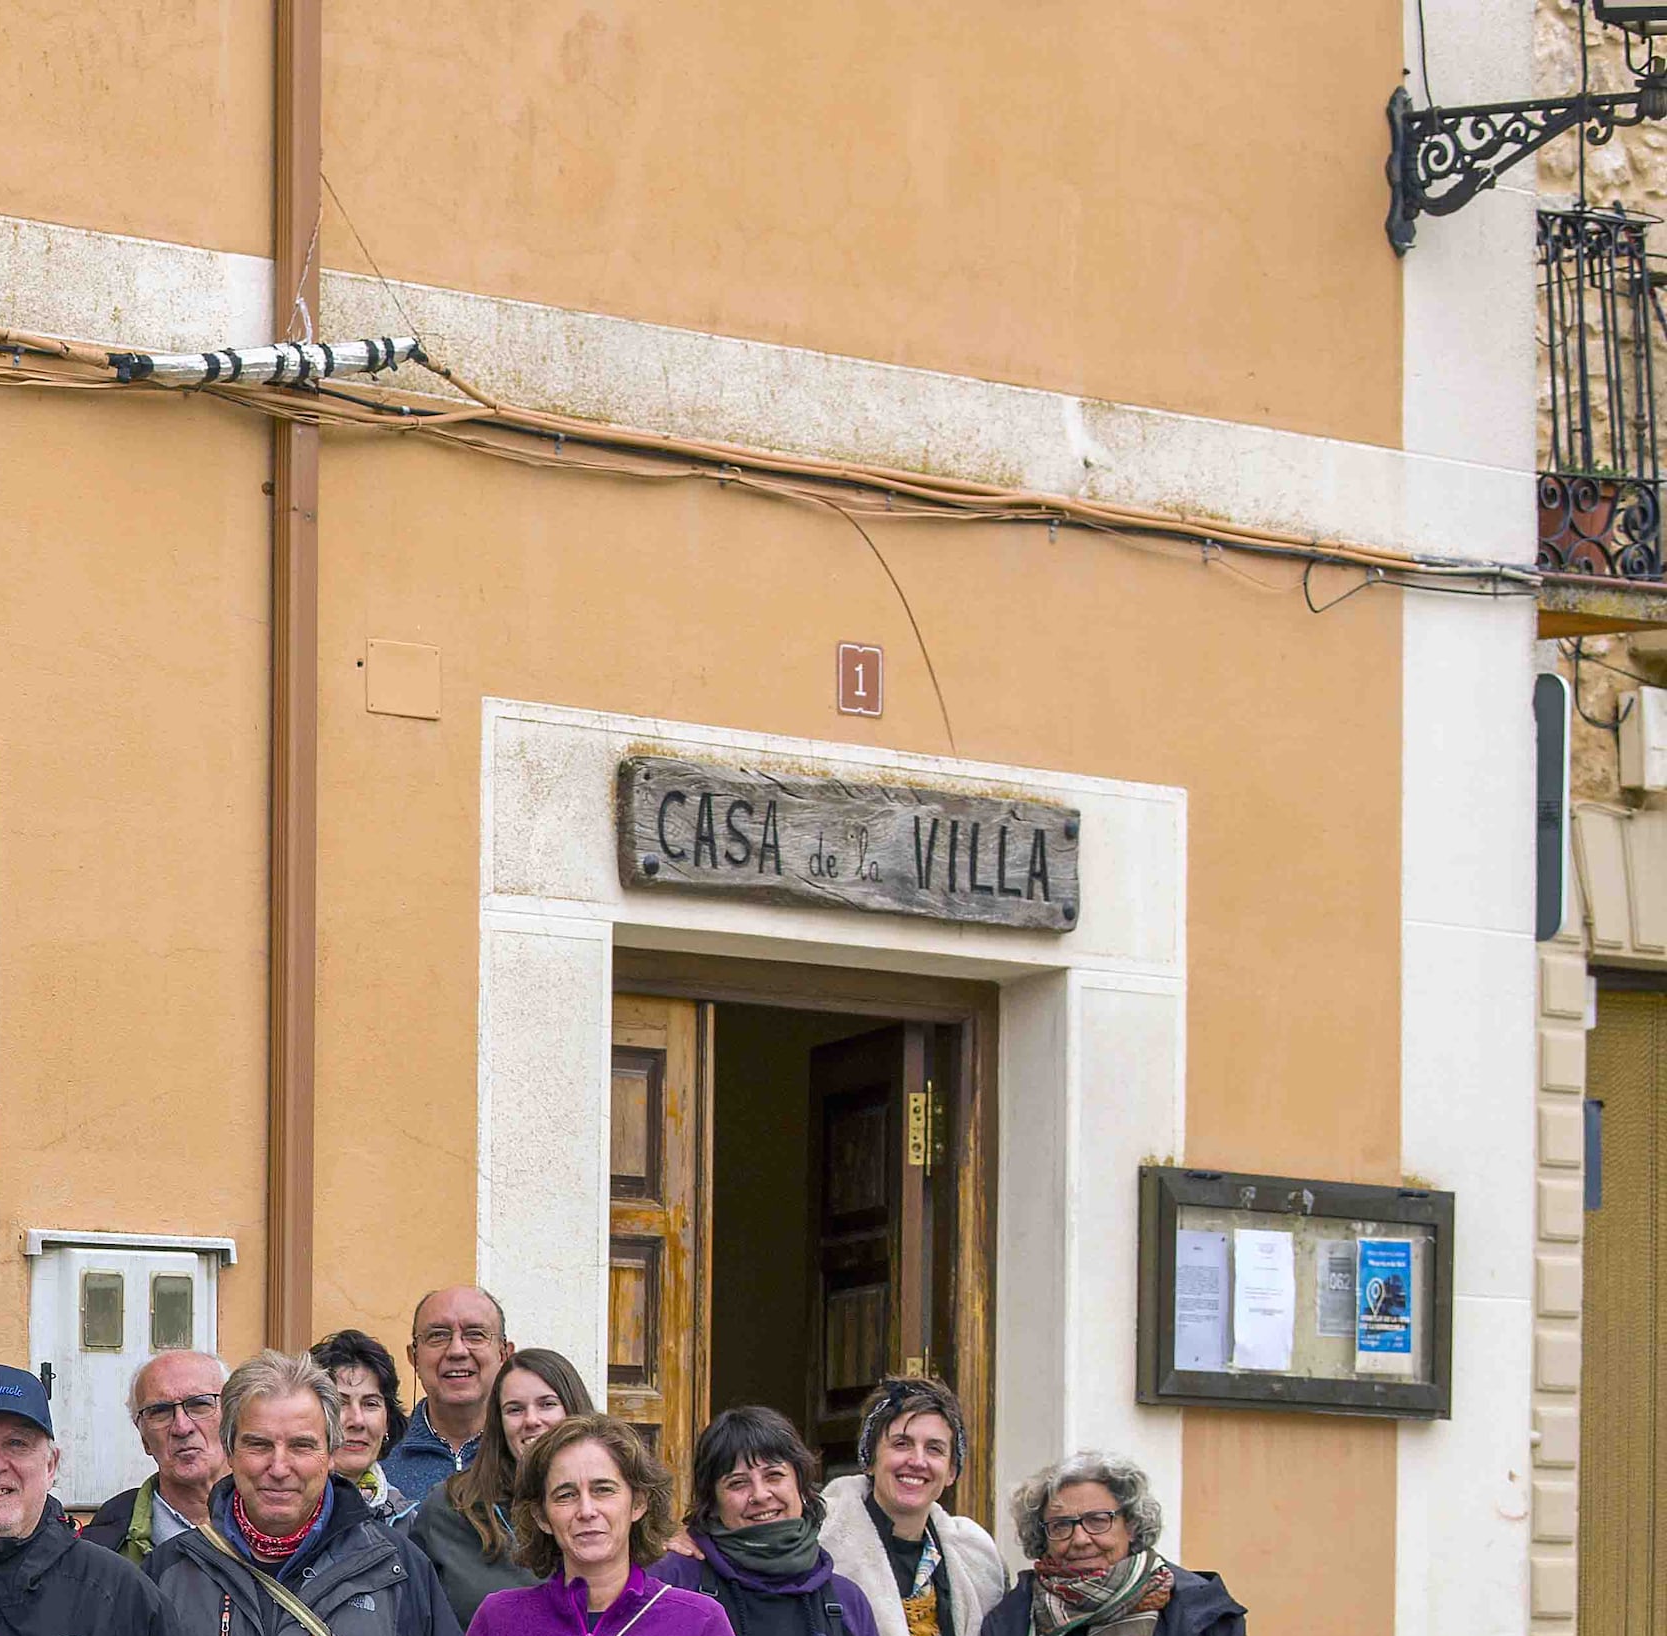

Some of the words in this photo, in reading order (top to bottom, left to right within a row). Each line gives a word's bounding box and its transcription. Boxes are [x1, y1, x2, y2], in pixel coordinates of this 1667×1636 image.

[854, 663, 867, 696] 1
[657, 790, 782, 876] CASA
[809, 831, 839, 878] de
[855, 826, 883, 882] la
[913, 814, 1051, 902] VILLA
